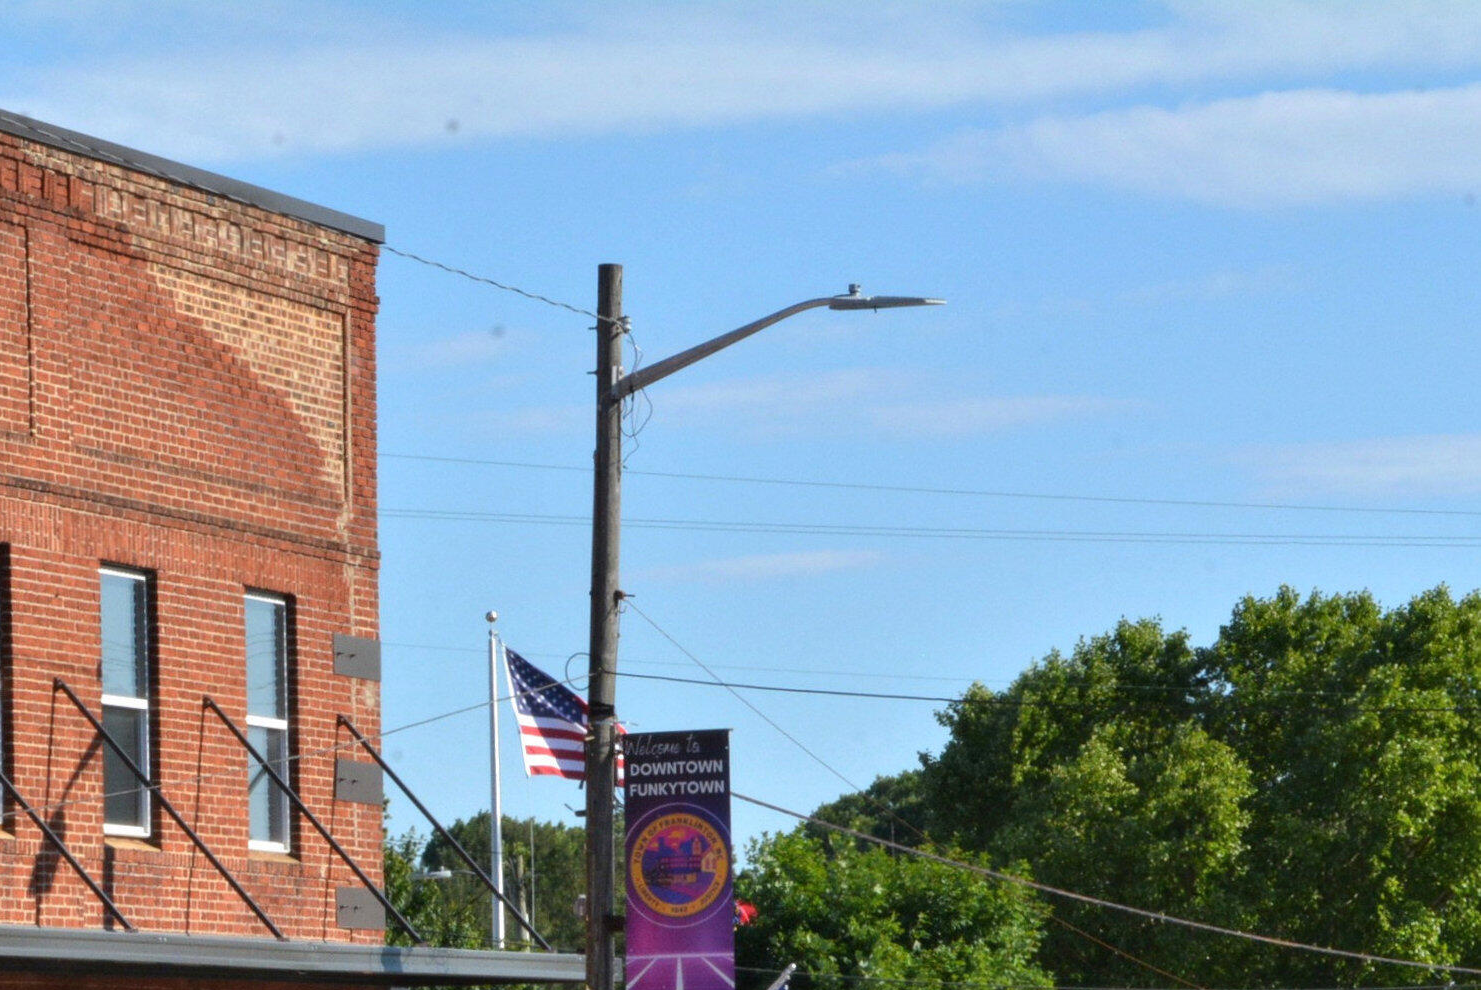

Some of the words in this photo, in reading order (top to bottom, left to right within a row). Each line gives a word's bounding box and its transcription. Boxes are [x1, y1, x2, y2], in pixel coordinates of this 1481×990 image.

[624, 734, 680, 755] Welcome
[685, 733, 700, 754] to
[630, 760, 723, 776] DOWNTOWN
[630, 780, 725, 797] FUNKYTOWN
